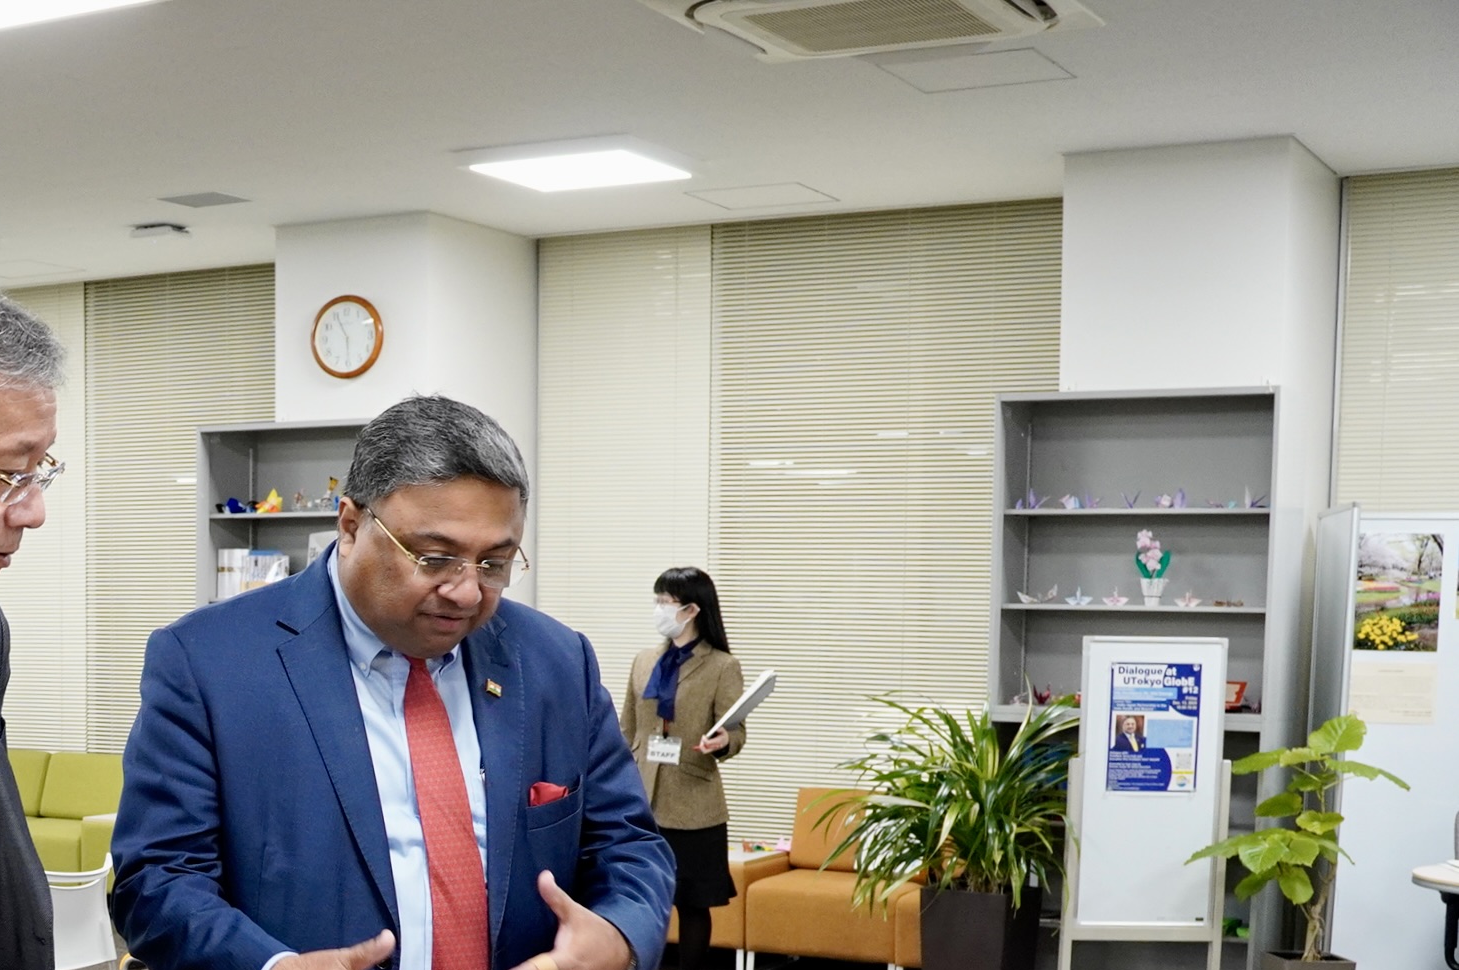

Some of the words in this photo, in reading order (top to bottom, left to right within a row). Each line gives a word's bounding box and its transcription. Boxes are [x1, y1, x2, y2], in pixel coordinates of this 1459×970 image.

[1118, 666, 1163, 676] Dialogue
[1166, 667, 1177, 676] at
[1123, 677, 1161, 686] UTokyo
[1163, 676, 1195, 687] GlobE
[649, 750, 676, 759] STAFF
